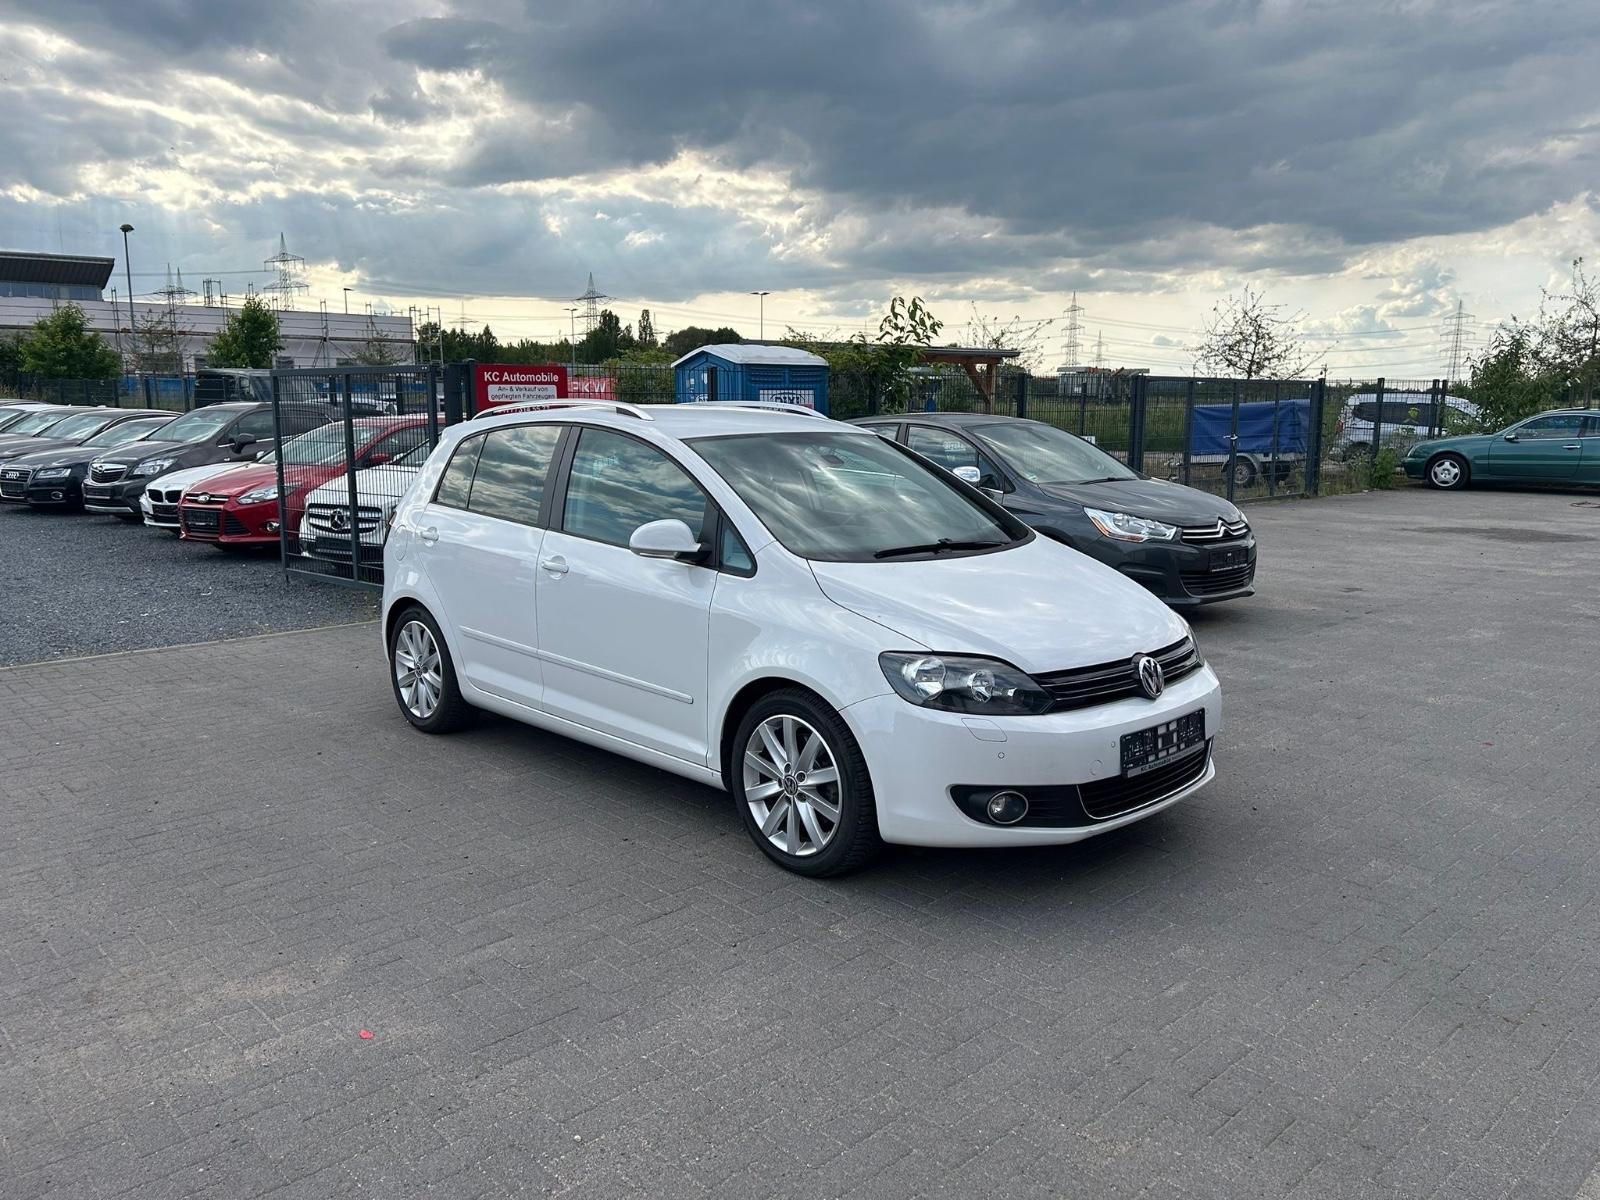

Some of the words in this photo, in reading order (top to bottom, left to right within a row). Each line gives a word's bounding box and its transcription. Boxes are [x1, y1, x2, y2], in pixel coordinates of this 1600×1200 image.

[484, 372, 500, 382] KC
[502, 372, 559, 382] Automobile
[491, 393, 521, 401] gepflegten
